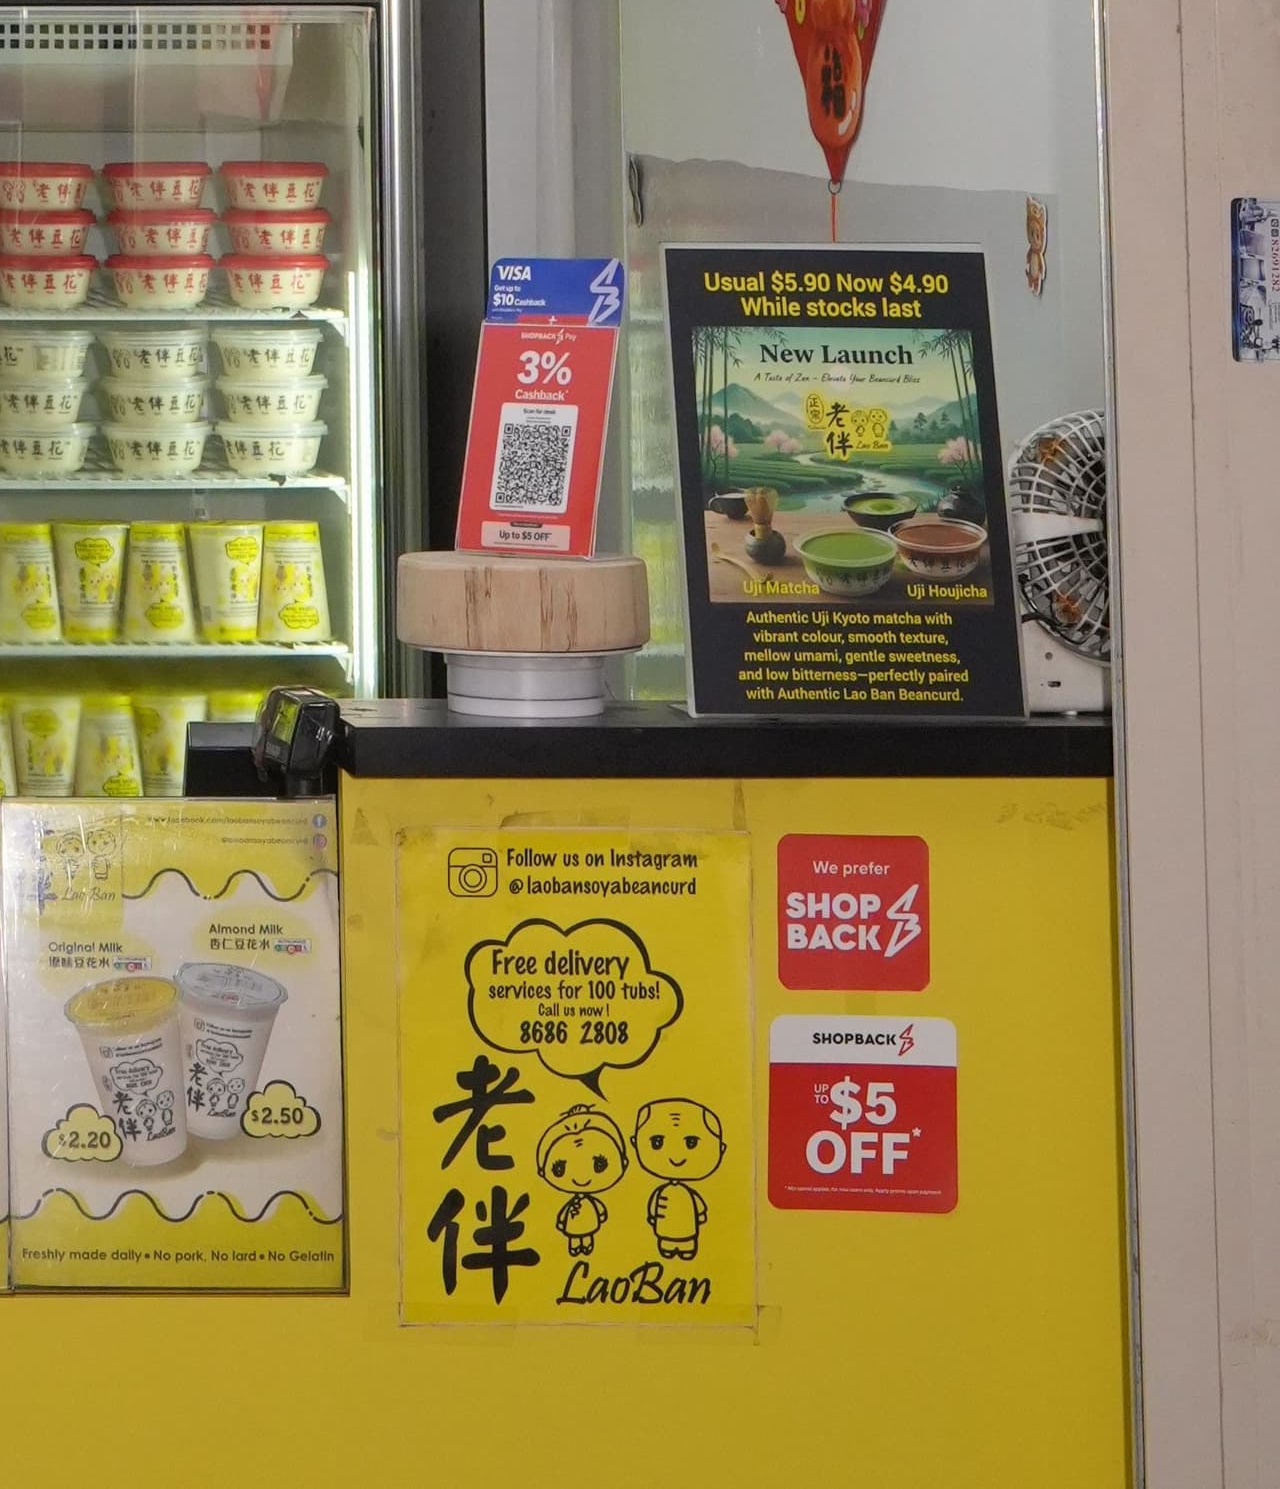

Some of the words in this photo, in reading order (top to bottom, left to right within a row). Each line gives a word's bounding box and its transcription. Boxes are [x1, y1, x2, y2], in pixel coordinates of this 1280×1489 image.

[497, 265, 532, 281] VISA
[704, 272, 764, 291] Usual
[772, 270, 830, 294] $5.90
[837, 273, 883, 292] Now
[890, 271, 948, 295] $4.90
[492, 293, 514, 307] $10
[741, 296, 800, 316] While
[807, 297, 876, 317] stocks
[882, 297, 921, 318] last
[759, 343, 814, 364] New
[821, 344, 913, 365] Launch
[517, 350, 572, 385] 3%
[826, 401, 853, 457] 老伴
[743, 580, 762, 597] Uji
[766, 581, 820, 595] Matcha
[907, 584, 925, 599] Uji
[929, 584, 987, 600] Houjicha
[746, 611, 809, 623] Authentic
[812, 611, 829, 626] Uji
[833, 612, 870, 627] Kyoto
[873, 612, 922, 624] matcha
[925, 612, 952, 624] with
[753, 630, 799, 642] vibrant
[802, 630, 844, 644] colour,
[848, 631, 896, 643] smooth
[900, 632, 948, 645] texture,
[744, 649, 790, 661] mellow
[794, 649, 842, 663] umami,
[845, 650, 885, 664] gentle
[889, 652, 960, 664] sweetness,
[739, 668, 763, 680] and
[766, 668, 788, 680] low
[929, 669, 968, 684] paired
[746, 687, 774, 699] with
[778, 687, 840, 700] Authentic
[844, 688, 867, 700] Lao
[871, 688, 895, 700] Ban
[899, 688, 963, 701] Beancurd.
[507, 848, 557, 867] Follow
[563, 854, 579, 867] us
[585, 854, 604, 867] on
[611, 848, 697, 870] Instagram
[813, 861, 838, 874] We
[843, 862, 890, 877] prefer
[786, 892, 881, 919] SHOP
[209, 924, 255, 934] Almond
[259, 924, 283, 934] Milk
[787, 923, 882, 950] BACK
[48, 942, 95, 954] Original
[99, 942, 122, 953] Milk
[493, 949, 537, 975] Free
[545, 949, 629, 978] delivery
[489, 981, 551, 999] services
[557, 980, 583, 999] for
[588, 980, 615, 999] 100
[620, 979, 660, 999] tubs!
[538, 1003, 559, 1017] Call
[564, 1006, 575, 1017] us
[520, 1021, 568, 1044] 8686
[580, 1021, 629, 1045] 2808
[813, 1033, 896, 1045] SHOPBACK
[813, 1083, 829, 1094] UP
[813, 1094, 829, 1104] TO
[829, 1075, 897, 1130] $5
[426, 1054, 541, 1305] 老伴
[20, 1248, 65, 1262] Freshly
[69, 1249, 107, 1260] made
[111, 1249, 142, 1263] daily
[154, 1250, 171, 1261] No
[175, 1250, 206, 1264] pork,
[211, 1250, 229, 1261] No
[232, 1250, 256, 1262] lard
[268, 1250, 285, 1262] No
[289, 1250, 334, 1262] Gelatin
